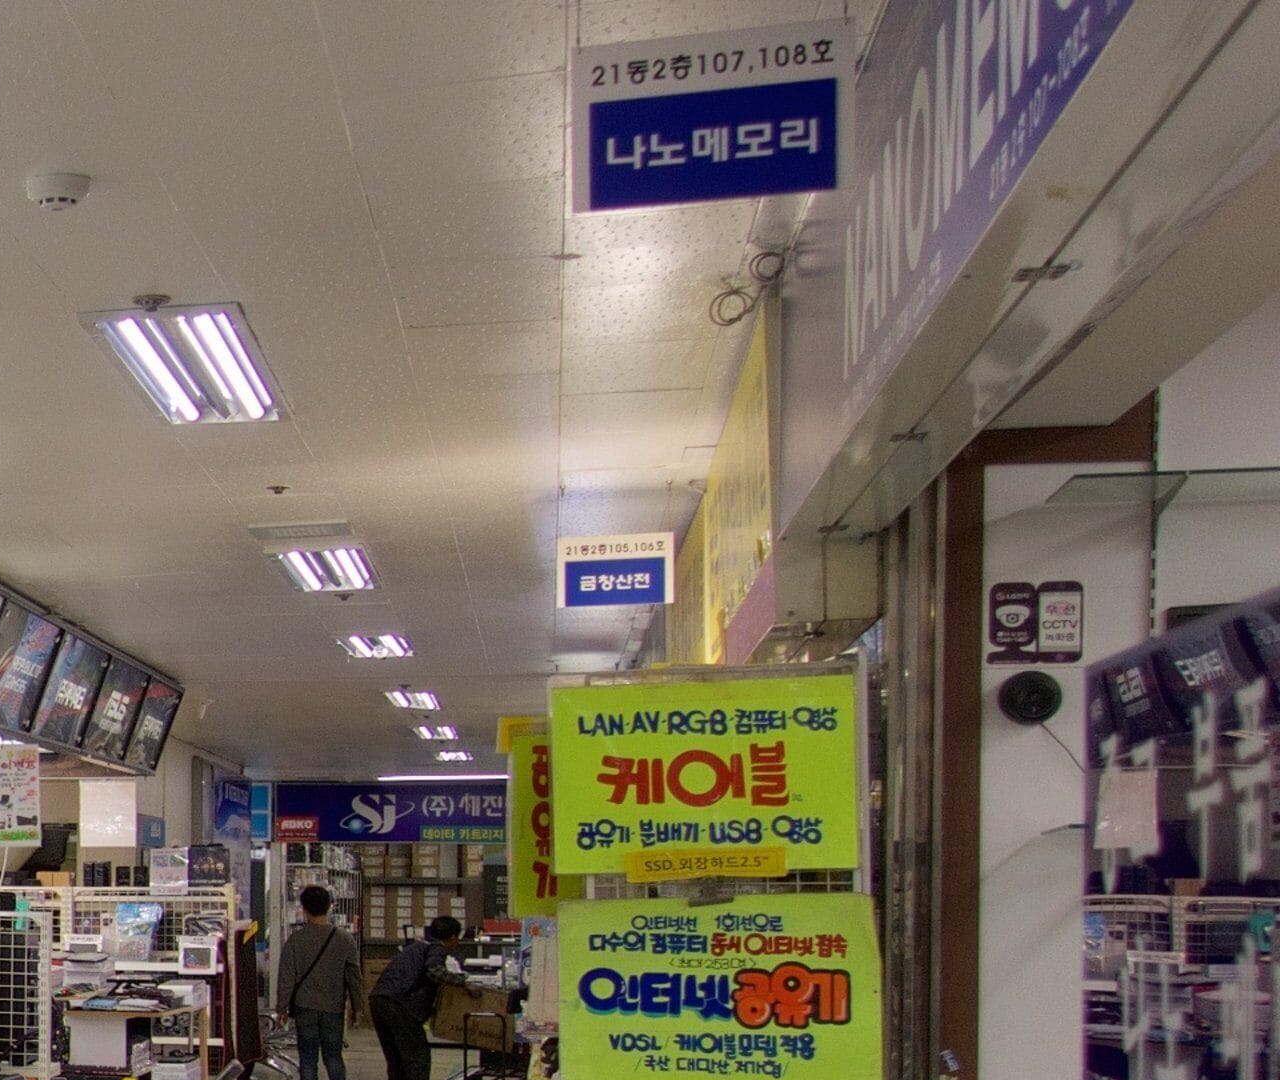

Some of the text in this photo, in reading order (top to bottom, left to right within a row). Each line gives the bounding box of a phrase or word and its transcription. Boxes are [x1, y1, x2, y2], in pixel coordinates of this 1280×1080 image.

[606, 117, 818, 170] 나노메모리
[580, 572, 651, 592] 금창산전
[1042, 620, 1078, 630] CCTV
[597, 741, 790, 806] 케이블
[280, 820, 314, 830] ABKO
[459, 828, 504, 840] 카트리지
[771, 816, 822, 845] 영상
[631, 914, 698, 933] 인터넷선
[588, 931, 848, 957] 다수의 컴퓨터 동시 인터넷 접속
[780, 1033, 816, 1058] 적용
